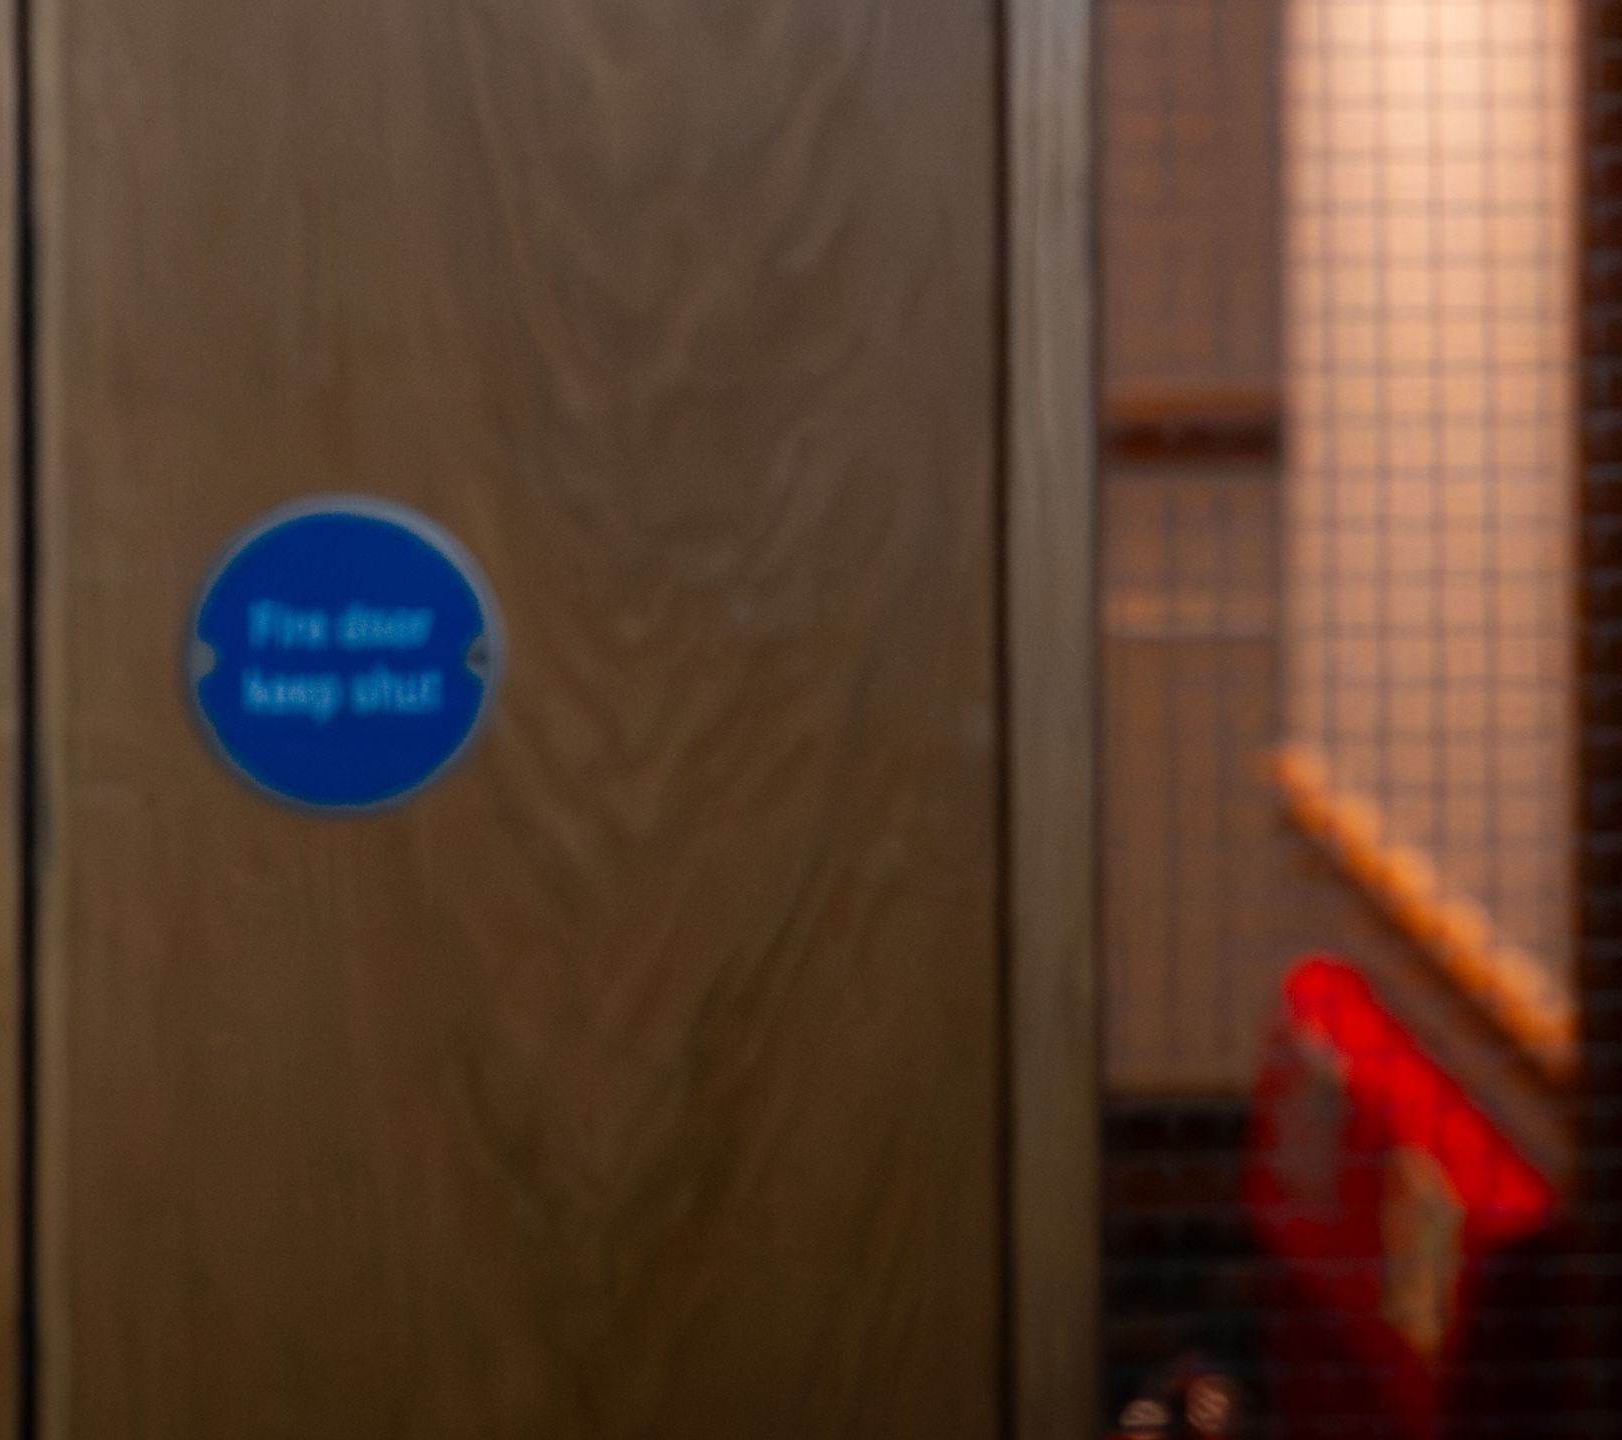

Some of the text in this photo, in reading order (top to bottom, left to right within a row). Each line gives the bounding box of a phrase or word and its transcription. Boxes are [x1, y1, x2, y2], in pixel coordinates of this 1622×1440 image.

[249, 599, 434, 651] Fire door
[242, 664, 441, 724] keep shut
